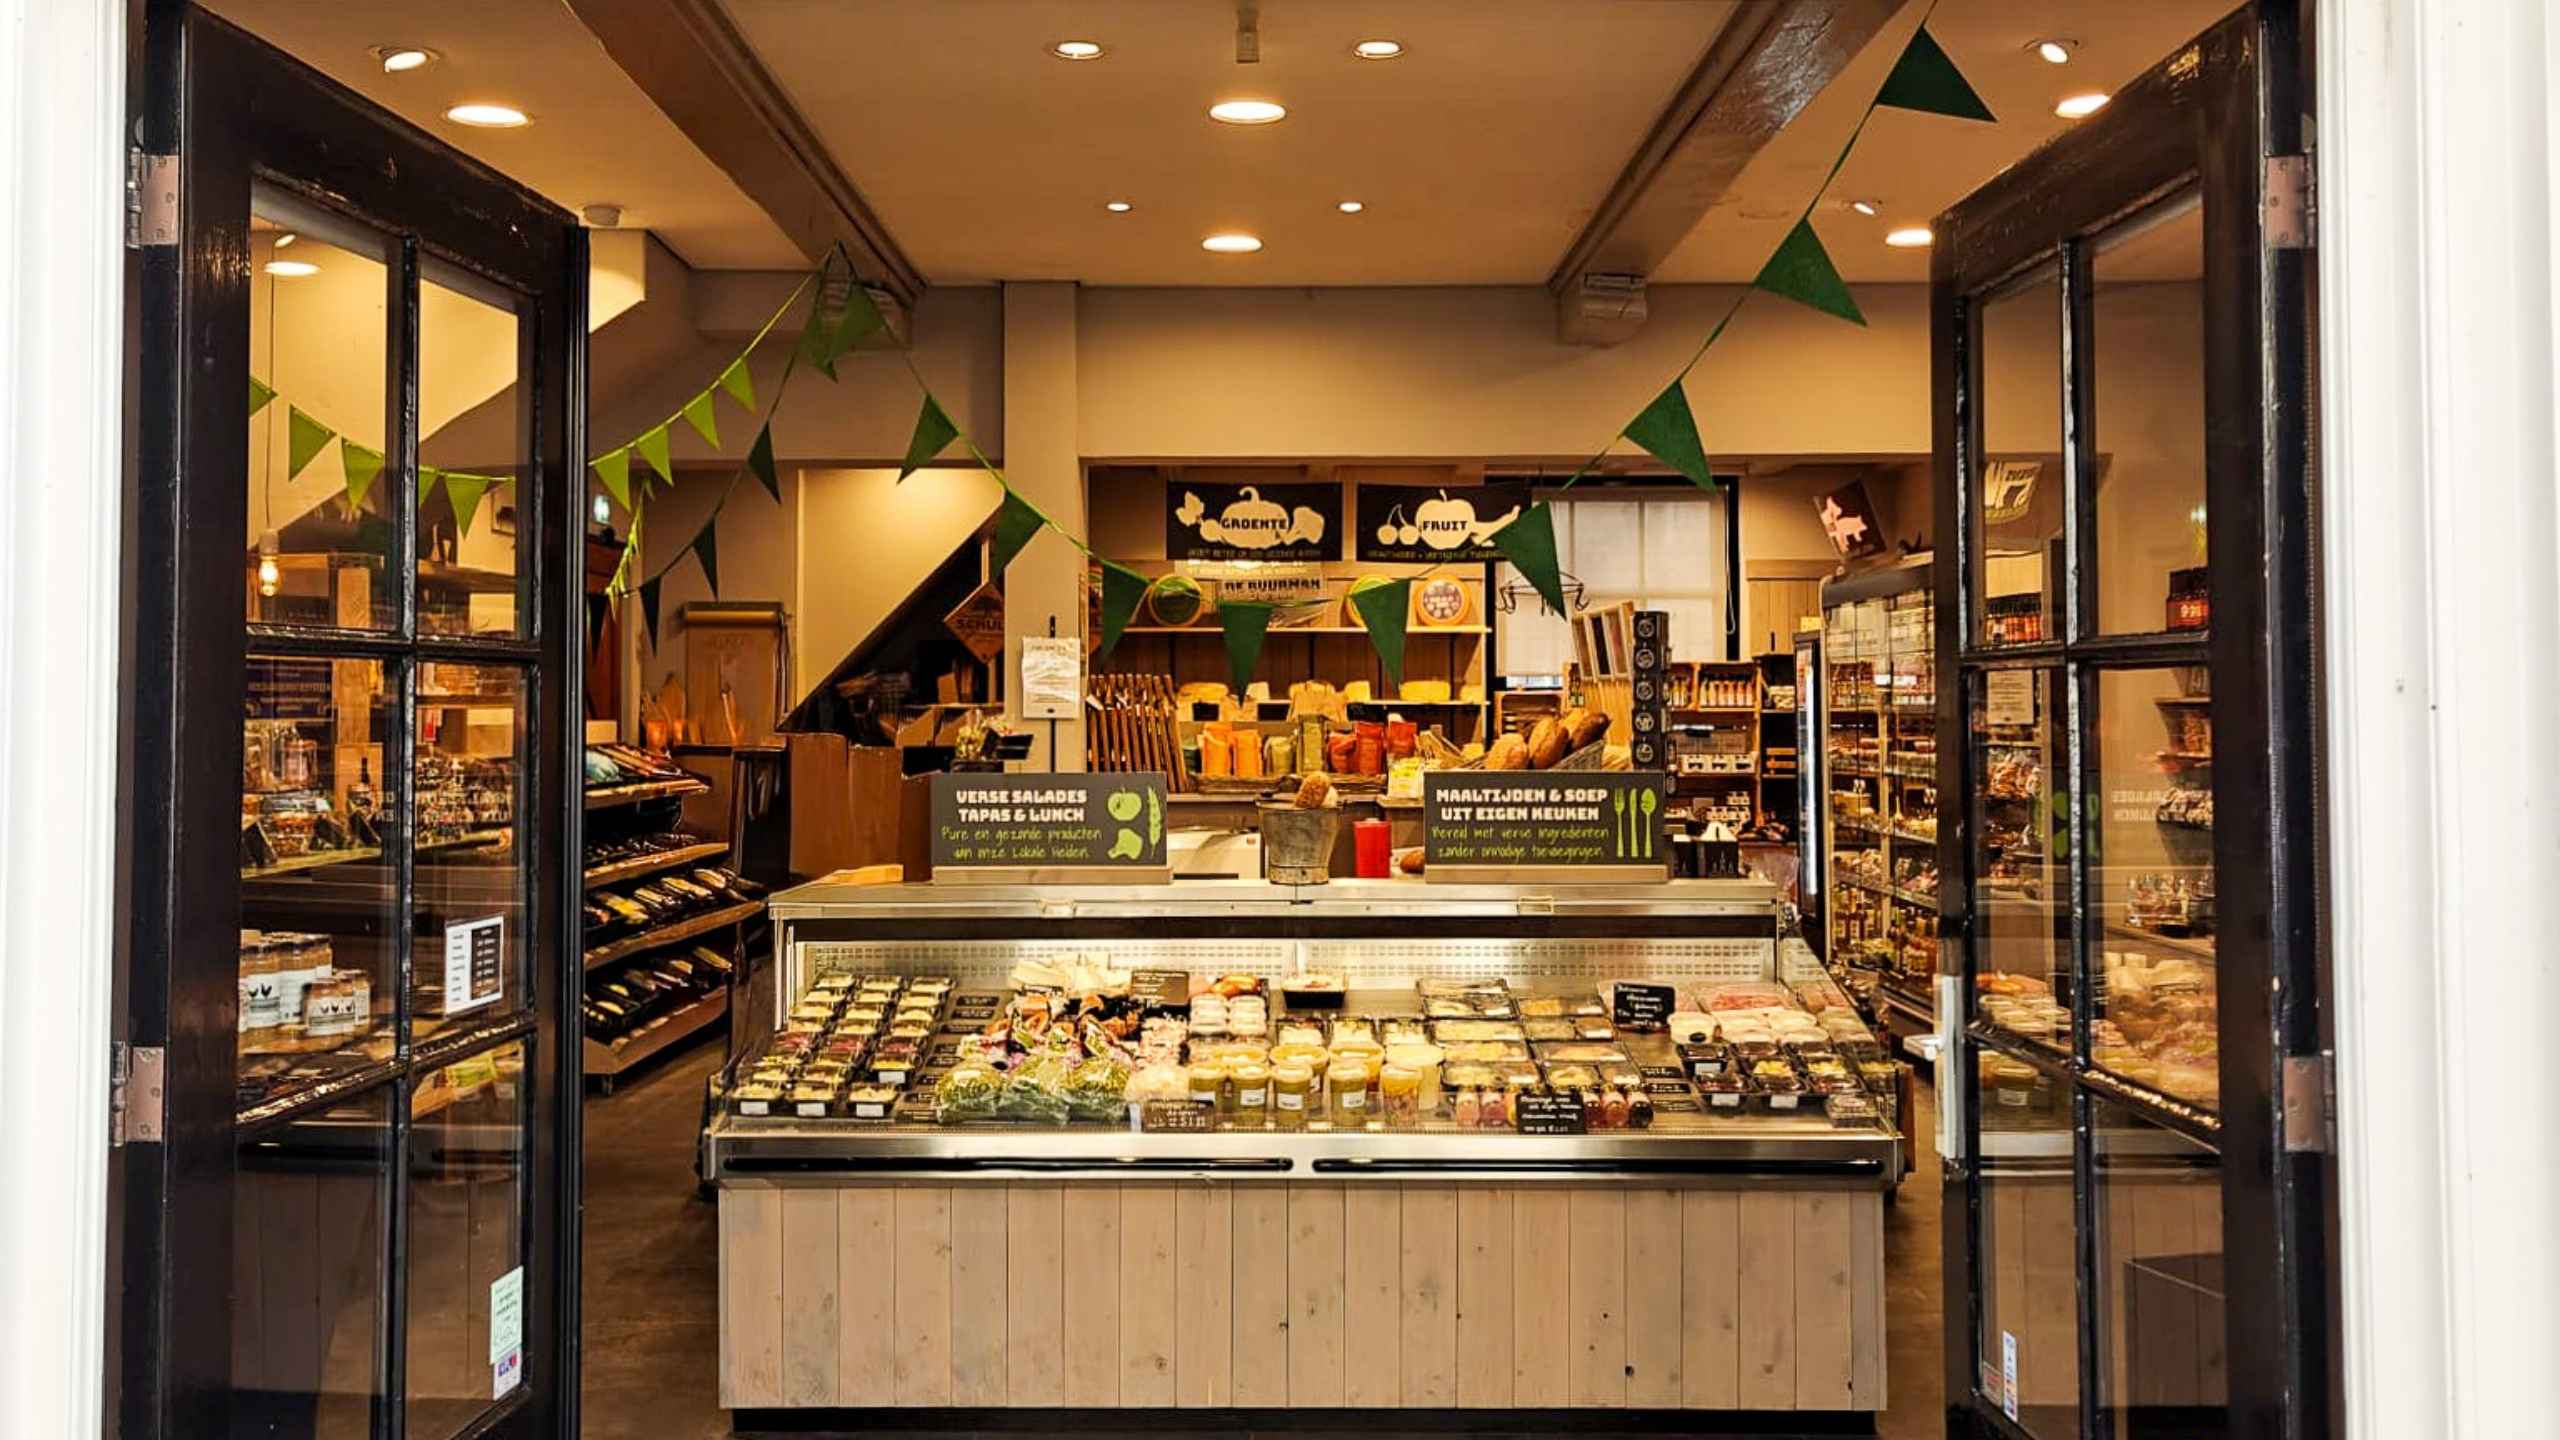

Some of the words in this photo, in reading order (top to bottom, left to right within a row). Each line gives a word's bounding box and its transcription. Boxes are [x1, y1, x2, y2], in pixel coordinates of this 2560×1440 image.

[1221, 517, 1287, 530] GROENTE
[1423, 520, 1468, 532] FRUIT
[956, 790, 1009, 804] VERSE
[1012, 789, 1088, 804] SALADES
[1436, 789, 1546, 802] MAALTIJDEN
[1549, 789, 1562, 802] &
[1564, 789, 1608, 802] SOEP
[958, 808, 1011, 822] TAPAS
[1014, 808, 1026, 822] &
[1029, 807, 1085, 822] LUNCH
[1441, 807, 1473, 821] UIT
[1475, 807, 1528, 821] EIGEN
[1531, 807, 1599, 821] KEUKEN
[941, 826, 969, 841] Pure
[975, 829, 989, 841] en
[1048, 826, 1102, 844] producten
[1473, 826, 1494, 839] met
